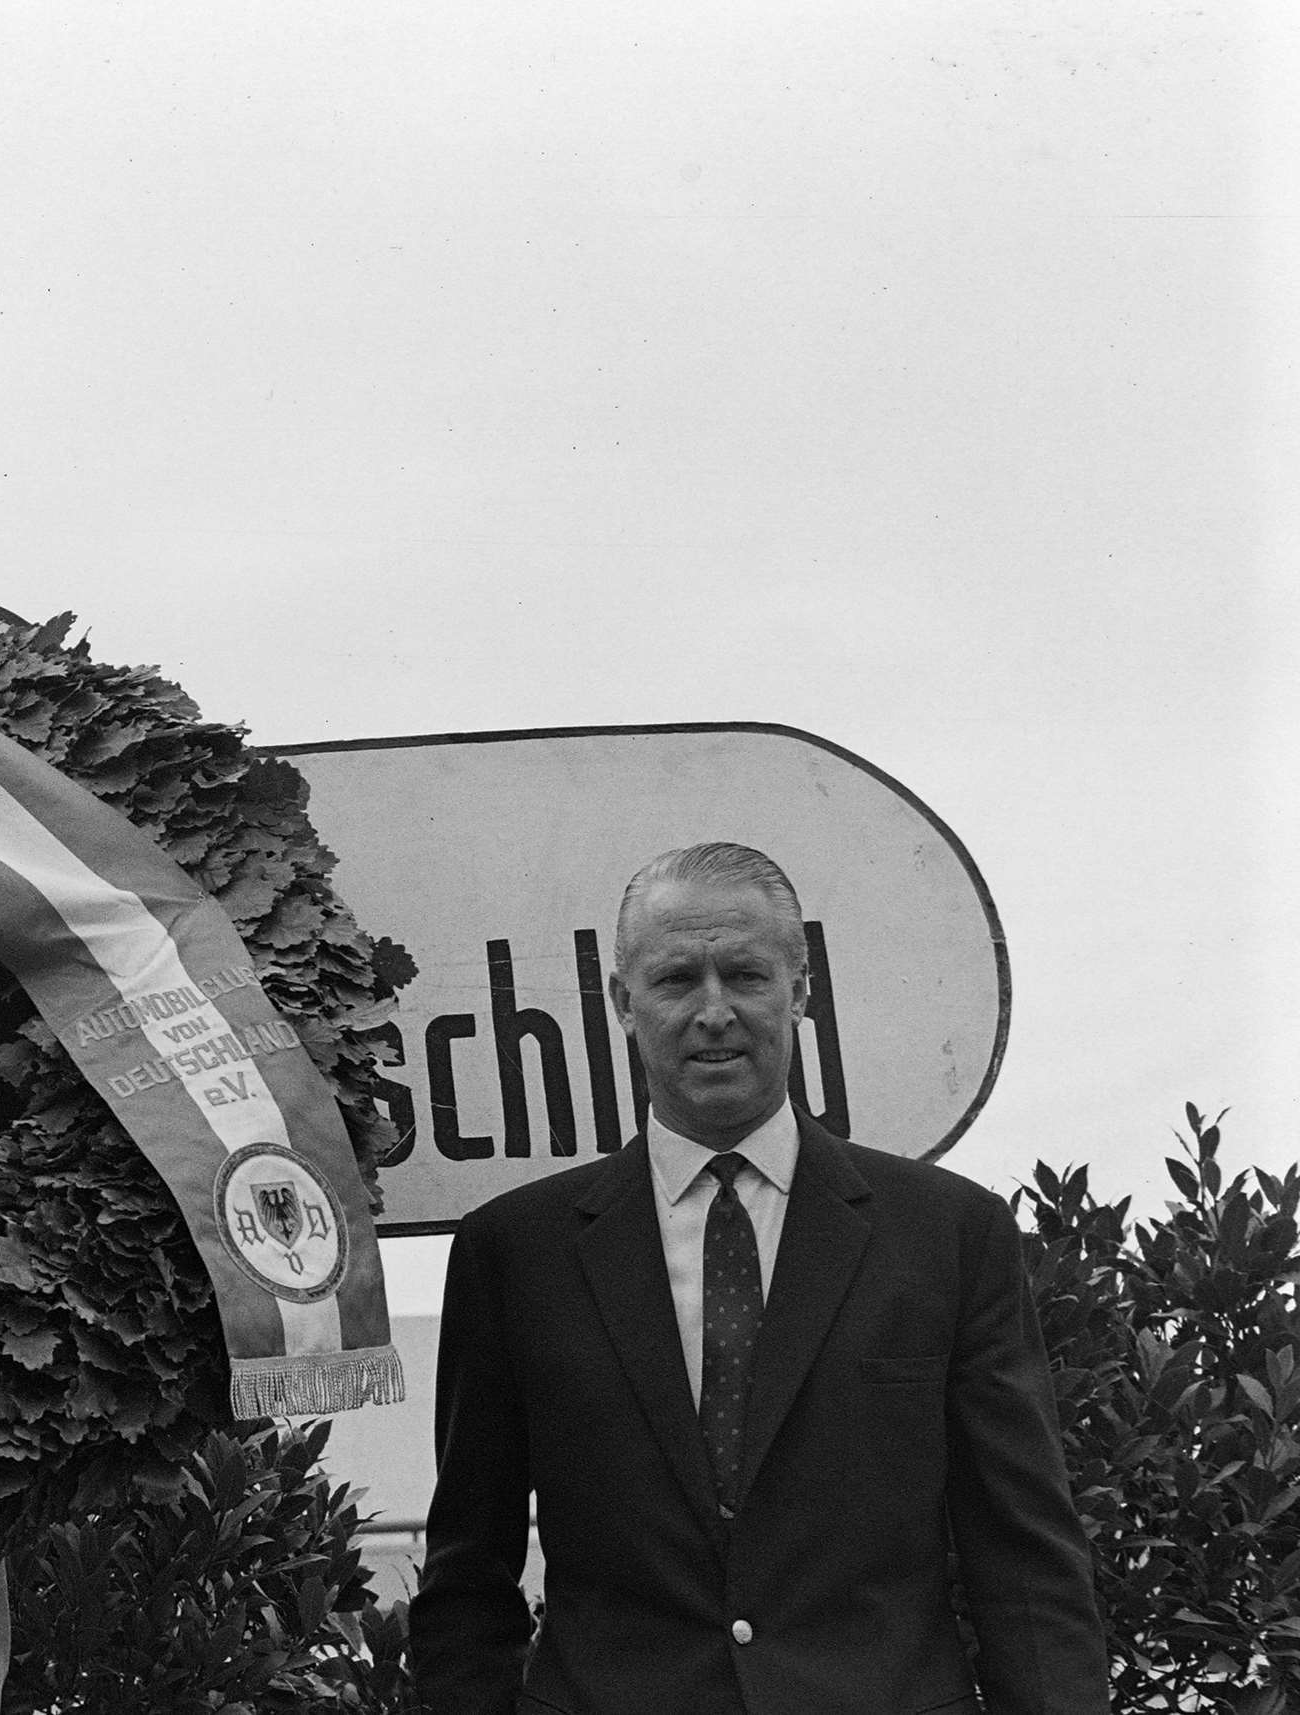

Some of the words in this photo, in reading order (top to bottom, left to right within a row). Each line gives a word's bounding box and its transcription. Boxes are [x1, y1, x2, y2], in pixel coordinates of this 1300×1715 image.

[76, 986, 208, 1047] AUTOMOBIL
[162, 1016, 210, 1043] VON
[106, 1020, 301, 1098] DEUTSCHLAND
[204, 1071, 257, 1106] e.V.
